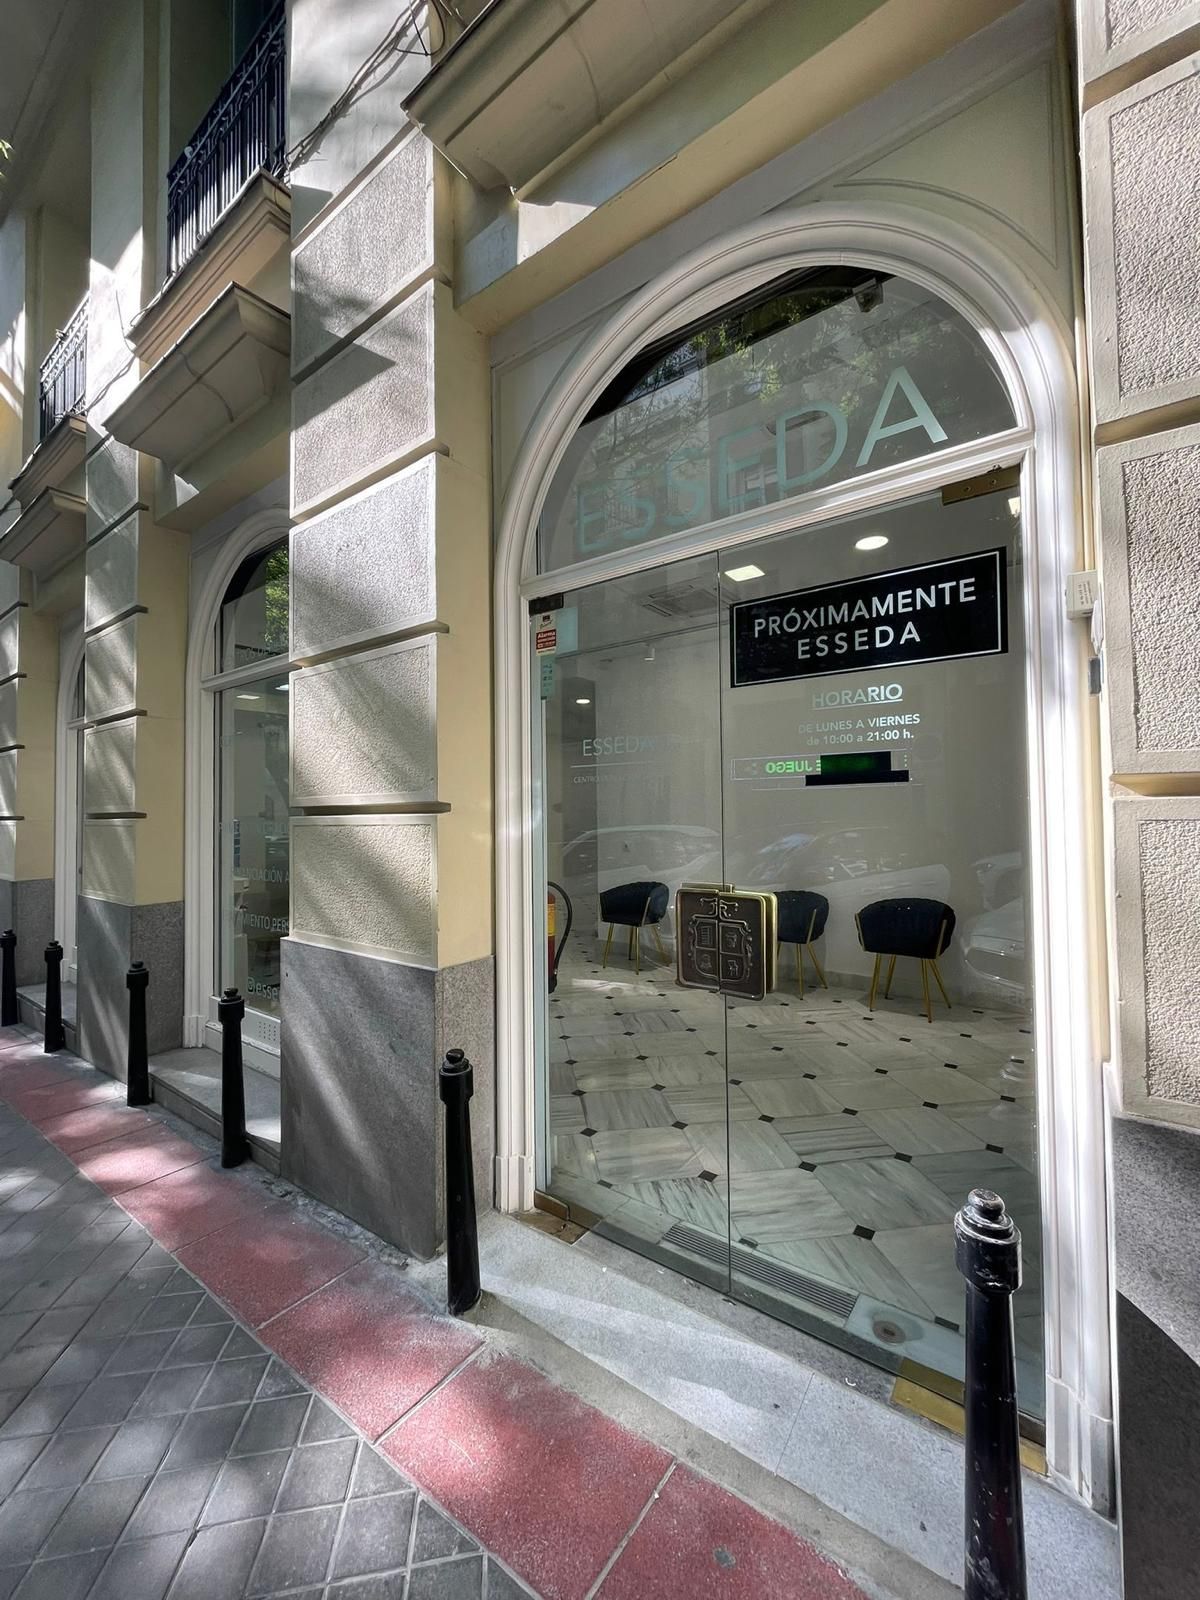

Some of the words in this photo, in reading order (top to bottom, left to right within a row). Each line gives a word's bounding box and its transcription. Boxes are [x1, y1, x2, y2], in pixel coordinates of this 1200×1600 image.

[575, 364, 949, 553] ESSEDA
[753, 577, 977, 639] PRÓXIMAMENTE
[797, 621, 921, 660] ESSEDA
[811, 683, 904, 709] HORARIO
[798, 723, 814, 735] DE
[816, 719, 853, 732] LUNES
[855, 719, 865, 729] A
[867, 713, 921, 728] VIERNES
[823, 733, 854, 745] 10:00
[856, 734, 864, 742] a
[866, 729, 900, 742] 21:00
[903, 728, 915, 739] h.
